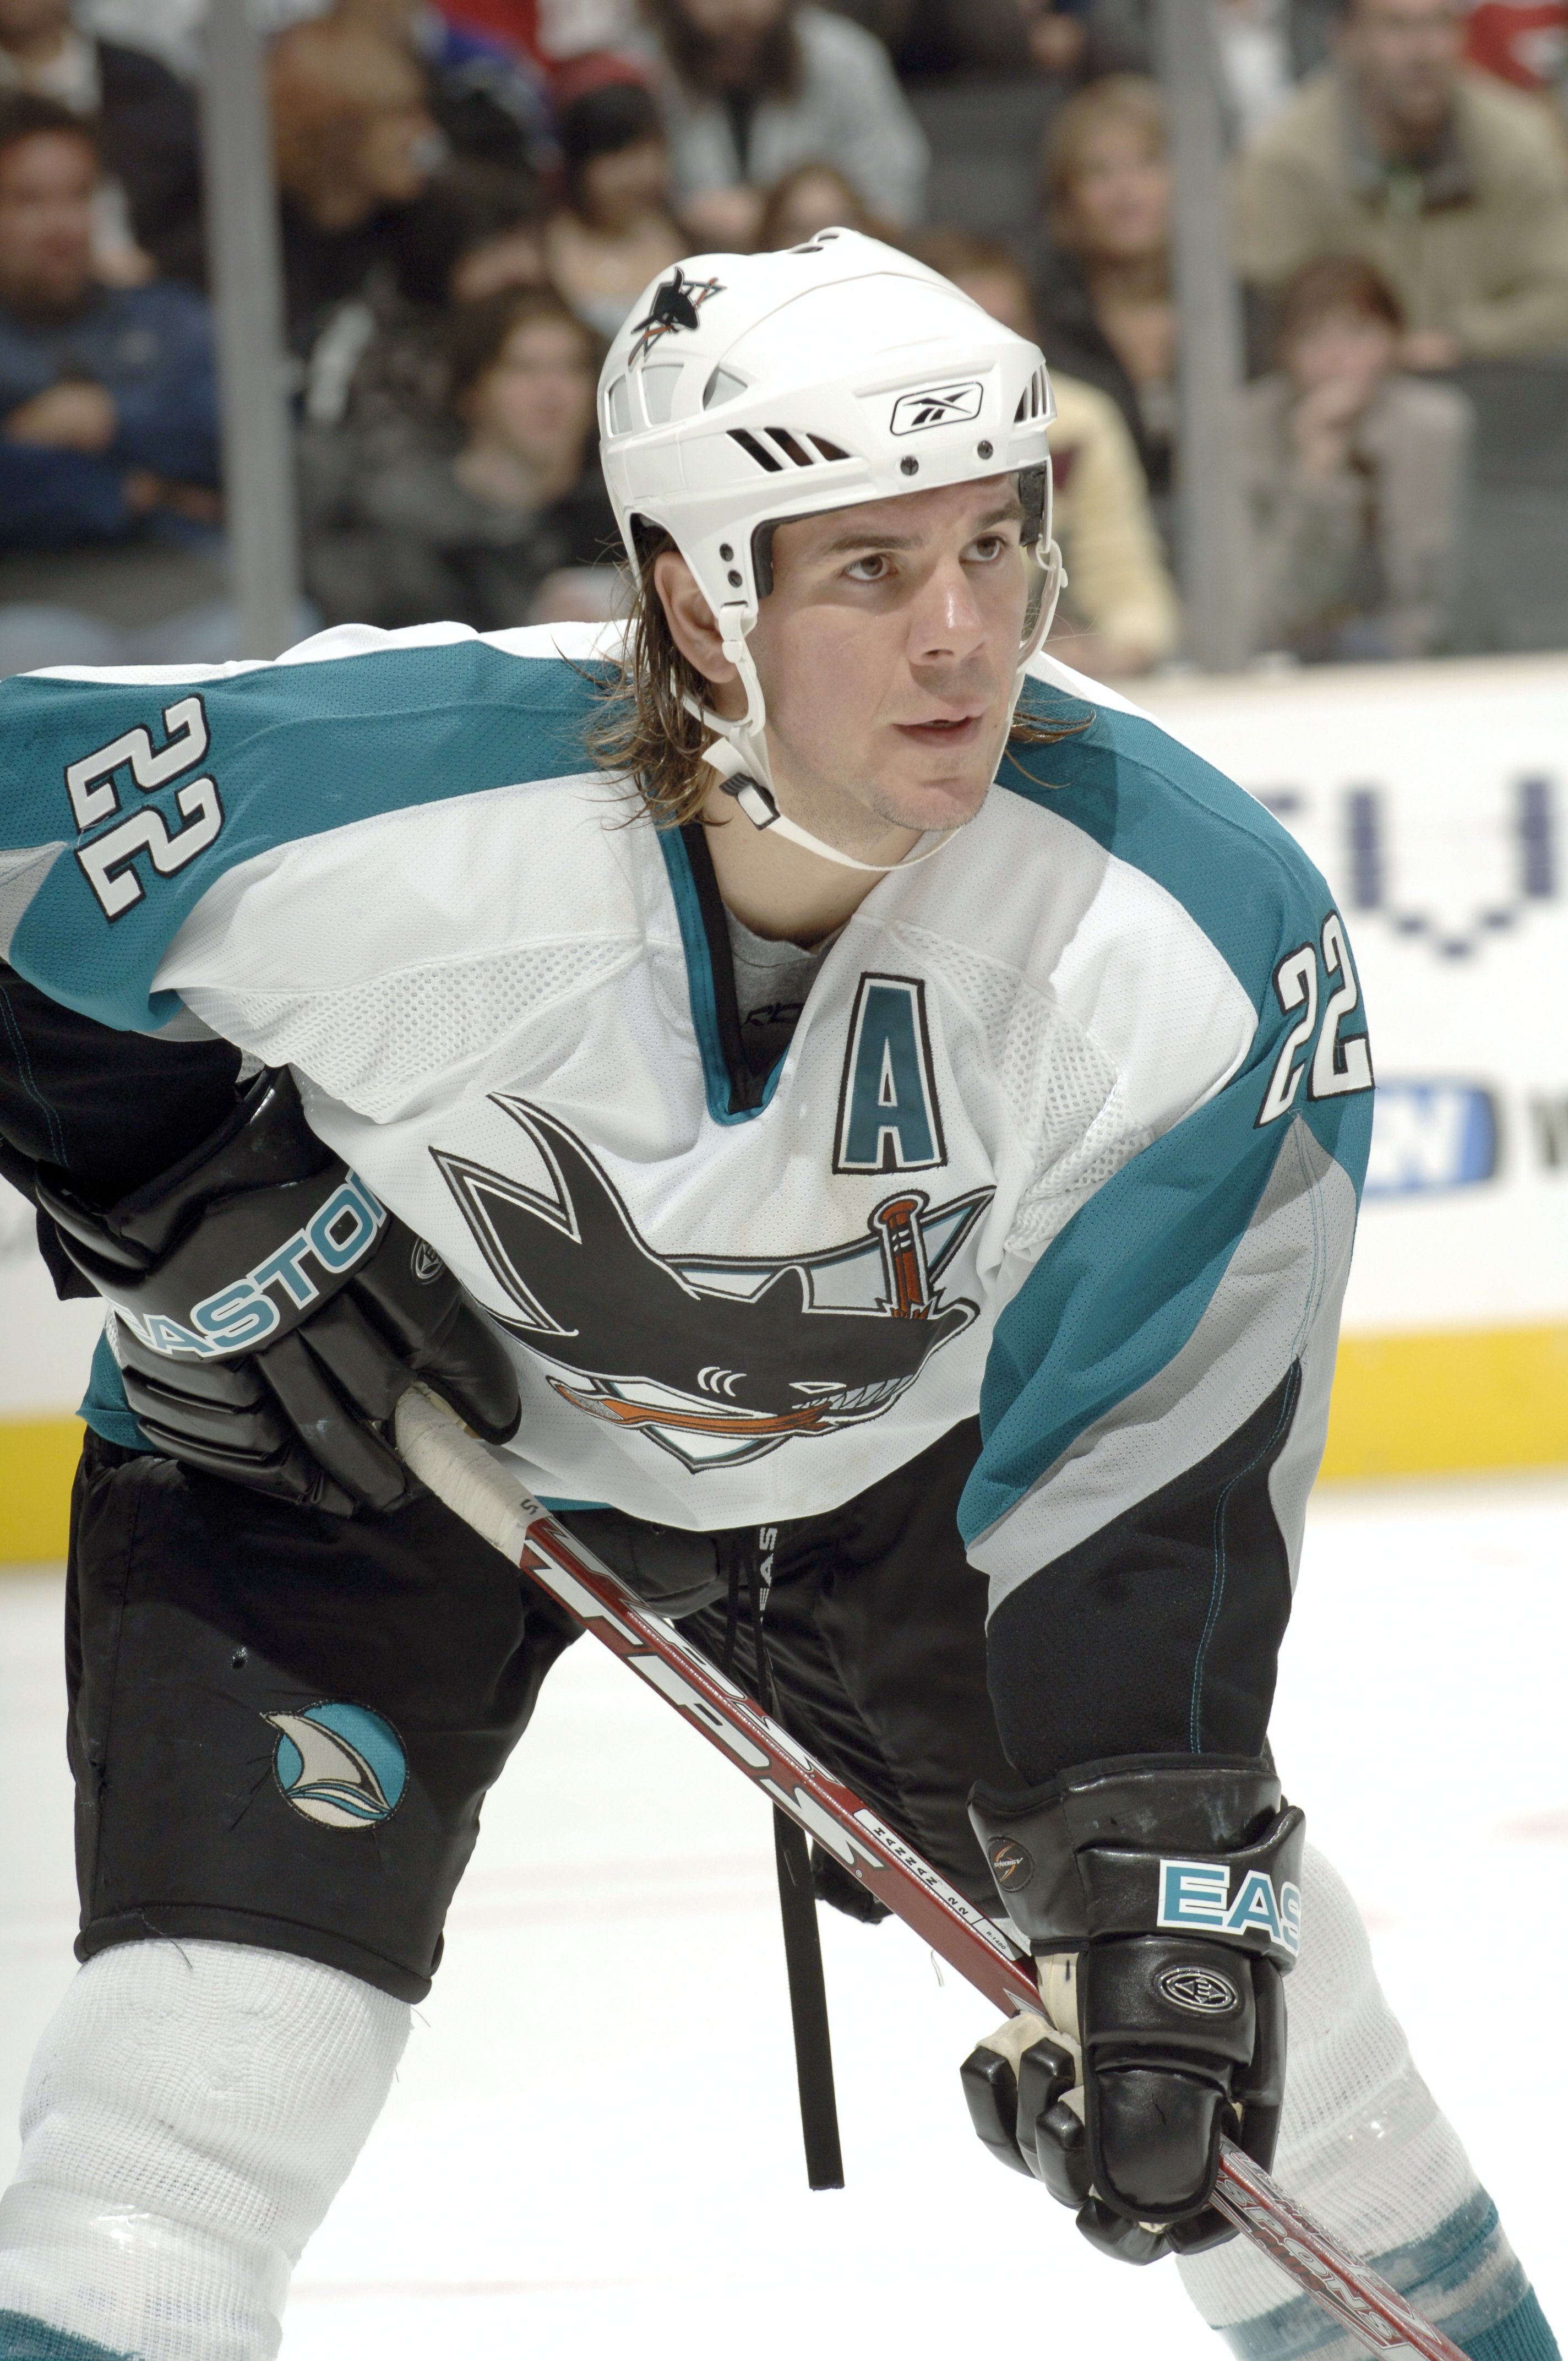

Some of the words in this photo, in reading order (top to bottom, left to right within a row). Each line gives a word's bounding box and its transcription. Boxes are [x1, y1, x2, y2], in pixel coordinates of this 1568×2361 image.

[63, 692, 225, 924] 22
[832, 971, 948, 1176] A
[1254, 909, 1376, 1129] 22
[523, 1539, 886, 1868] TPS
[873, 1827, 938, 1886] HANNAN
[948, 1896, 970, 1916] 22
[1215, 2169, 1431, 2361] SPONS
